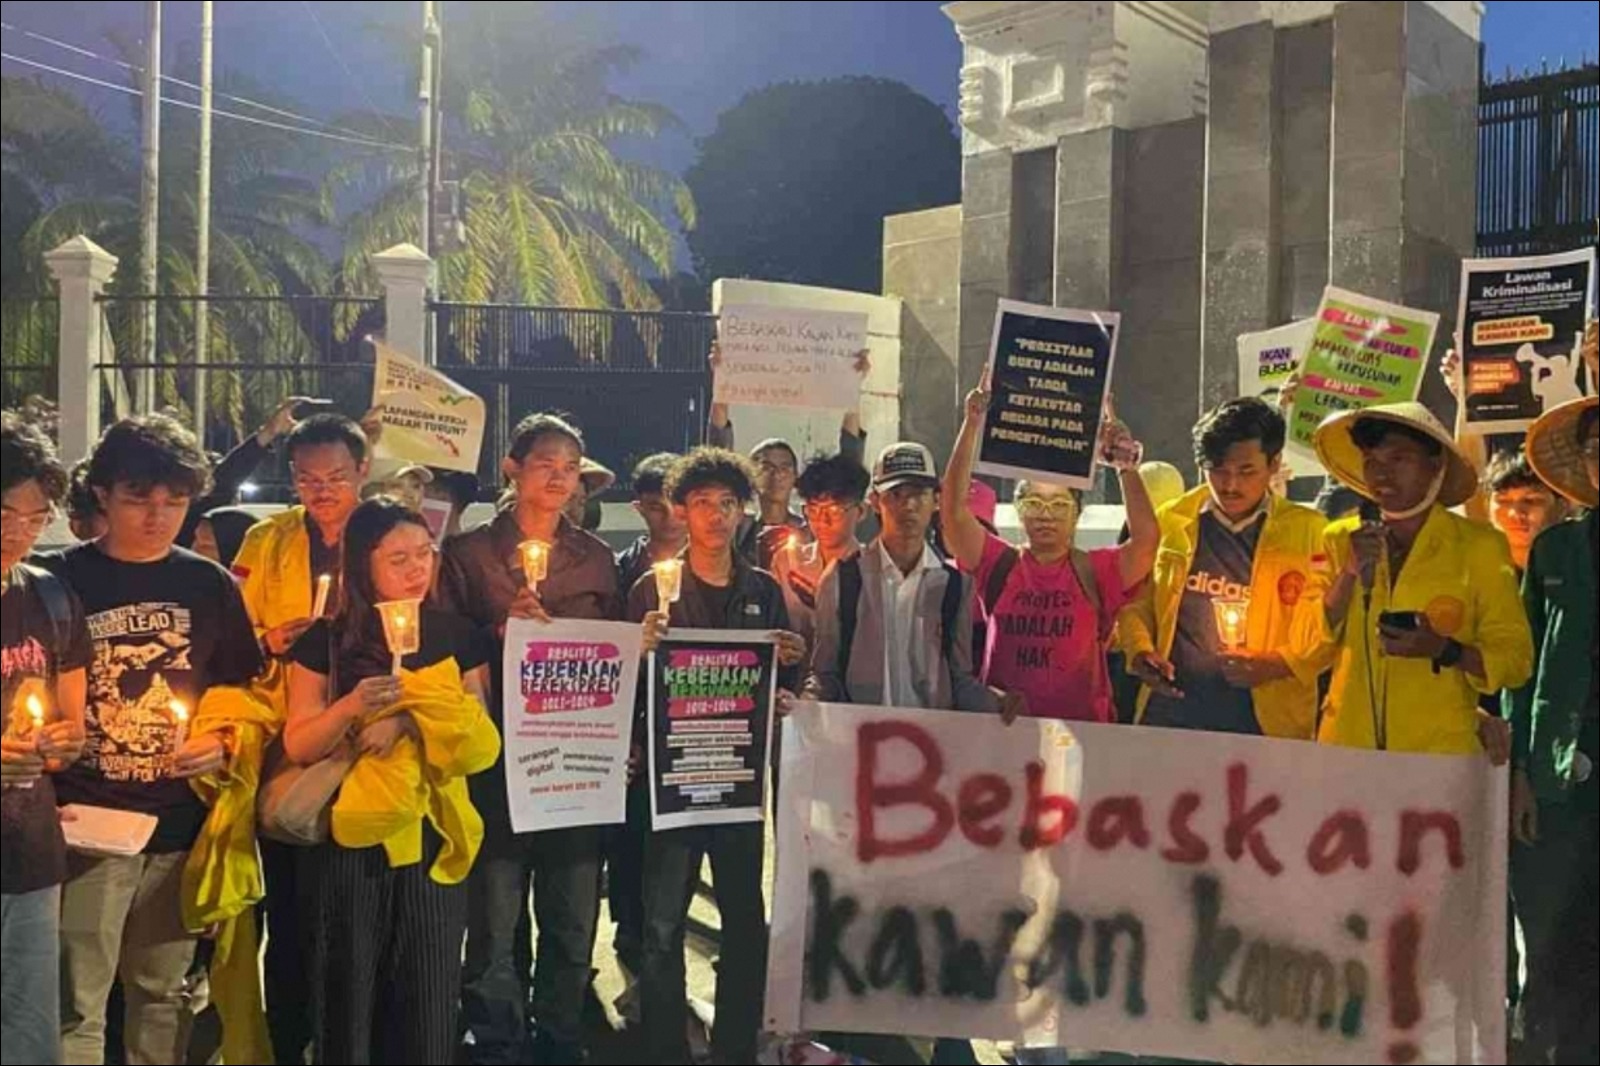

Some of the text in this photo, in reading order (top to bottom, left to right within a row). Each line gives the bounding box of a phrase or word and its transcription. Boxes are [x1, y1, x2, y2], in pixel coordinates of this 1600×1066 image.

[1505, 271, 1551, 284] Lawan
[1482, 279, 1573, 298] Kriminalisasi
[1259, 347, 1292, 362] IKAN
[1043, 361, 1095, 377] ADALAH
[384, 405, 468, 426] LAPANGAN KERJA
[1051, 417, 1084, 434] PADA
[382, 415, 467, 437] MALAH TURUN?
[1186, 571, 1252, 600] adidas
[128, 612, 170, 632] LEAD
[1003, 614, 1074, 637] ADALAH
[1015, 646, 1049, 668] HAK
[521, 660, 622, 678] KEBEBASAN
[664, 665, 762, 685] KEBEBASAN
[521, 677, 620, 695] BEREKSPRESI
[855, 720, 1465, 876] Bebaskan
[804, 867, 1149, 1019] kawan
